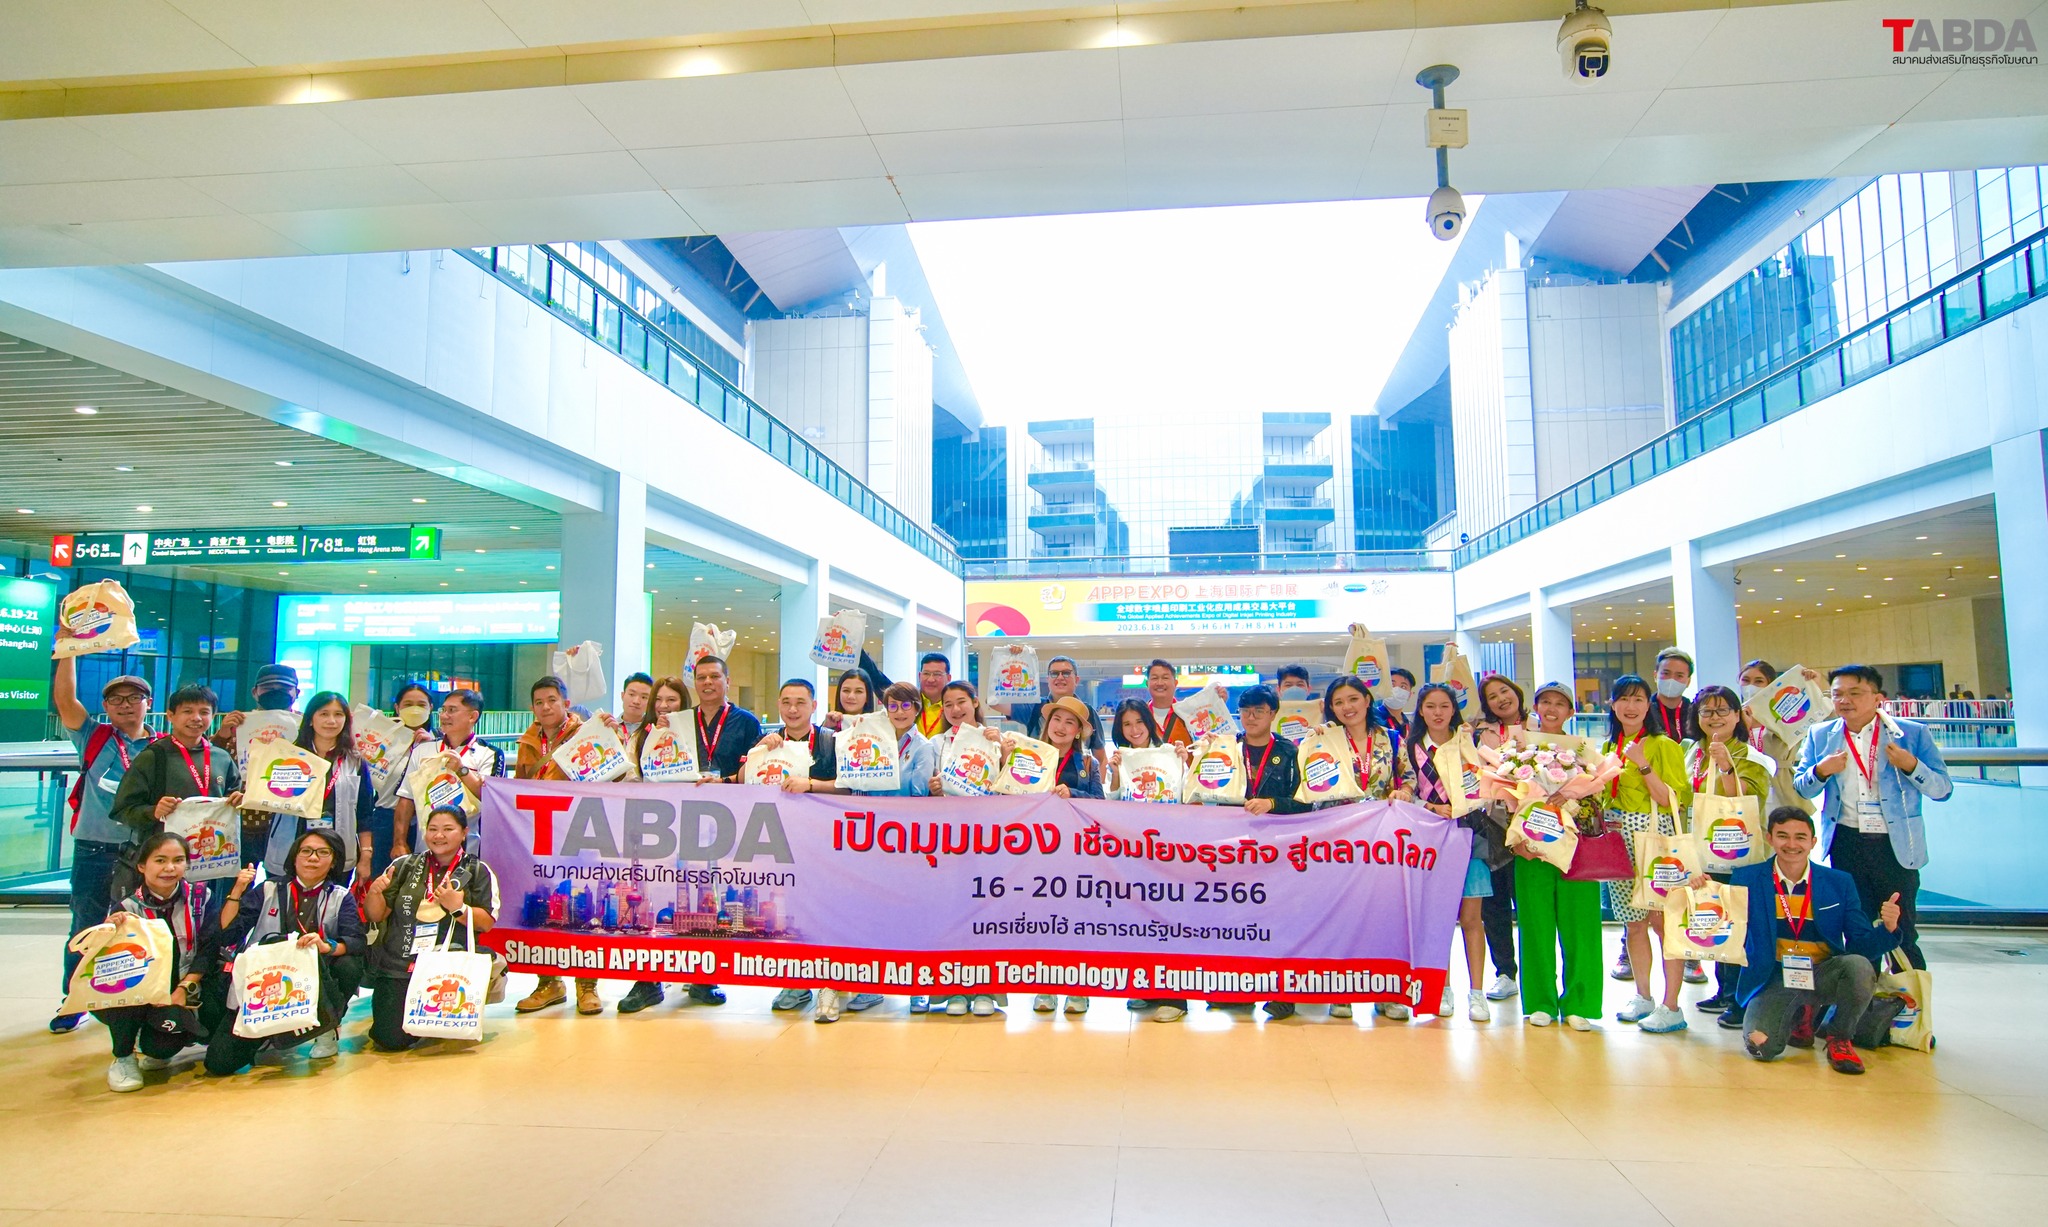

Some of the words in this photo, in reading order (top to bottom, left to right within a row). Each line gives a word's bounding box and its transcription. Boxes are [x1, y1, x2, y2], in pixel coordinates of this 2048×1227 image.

[267, 535, 295, 545] 电影院
[1196, 583, 1298, 597] 上海国际广印展
[1117, 623, 1174, 632] 2023.6.18-21
[11, 690, 39, 699] Visitor
[841, 771, 894, 779] APPPEXPO
[515, 794, 795, 864] TABDA
[833, 811, 1062, 868] เปิดมุมมอง
[1073, 821, 1278, 872] เชื่อมโยงธุรกิจ
[1286, 829, 1438, 872] สู่ตลาดโลก
[533, 862, 796, 889] สมาคมส่งเสริมไทยธุรกิจโฆษณา
[971, 876, 1006, 899] 16
[1032, 876, 1067, 899] 20
[1076, 874, 1184, 908] มิถุนายน
[1194, 881, 1268, 904] 2566
[972, 912, 1069, 936] นครเซี่ยงไฮ้
[1073, 920, 1271, 943] สาธารณรัฐประชาชนจีน
[96, 958, 136, 971] APPPEXPO
[505, 939, 604, 969] Shanghai
[608, 947, 716, 974] APPPEXPO
[733, 952, 879, 985] International
[883, 961, 913, 986] Ad
[918, 964, 935, 986] &
[939, 961, 991, 987] Sign
[995, 961, 1128, 990] Technology
[1133, 967, 1150, 989] &
[1154, 965, 1279, 993] Equipment
[1283, 970, 1402, 993] Exhibition
[244, 1007, 310, 1025] PPPEXPO
[407, 1018, 478, 1028] APPPEXPO
